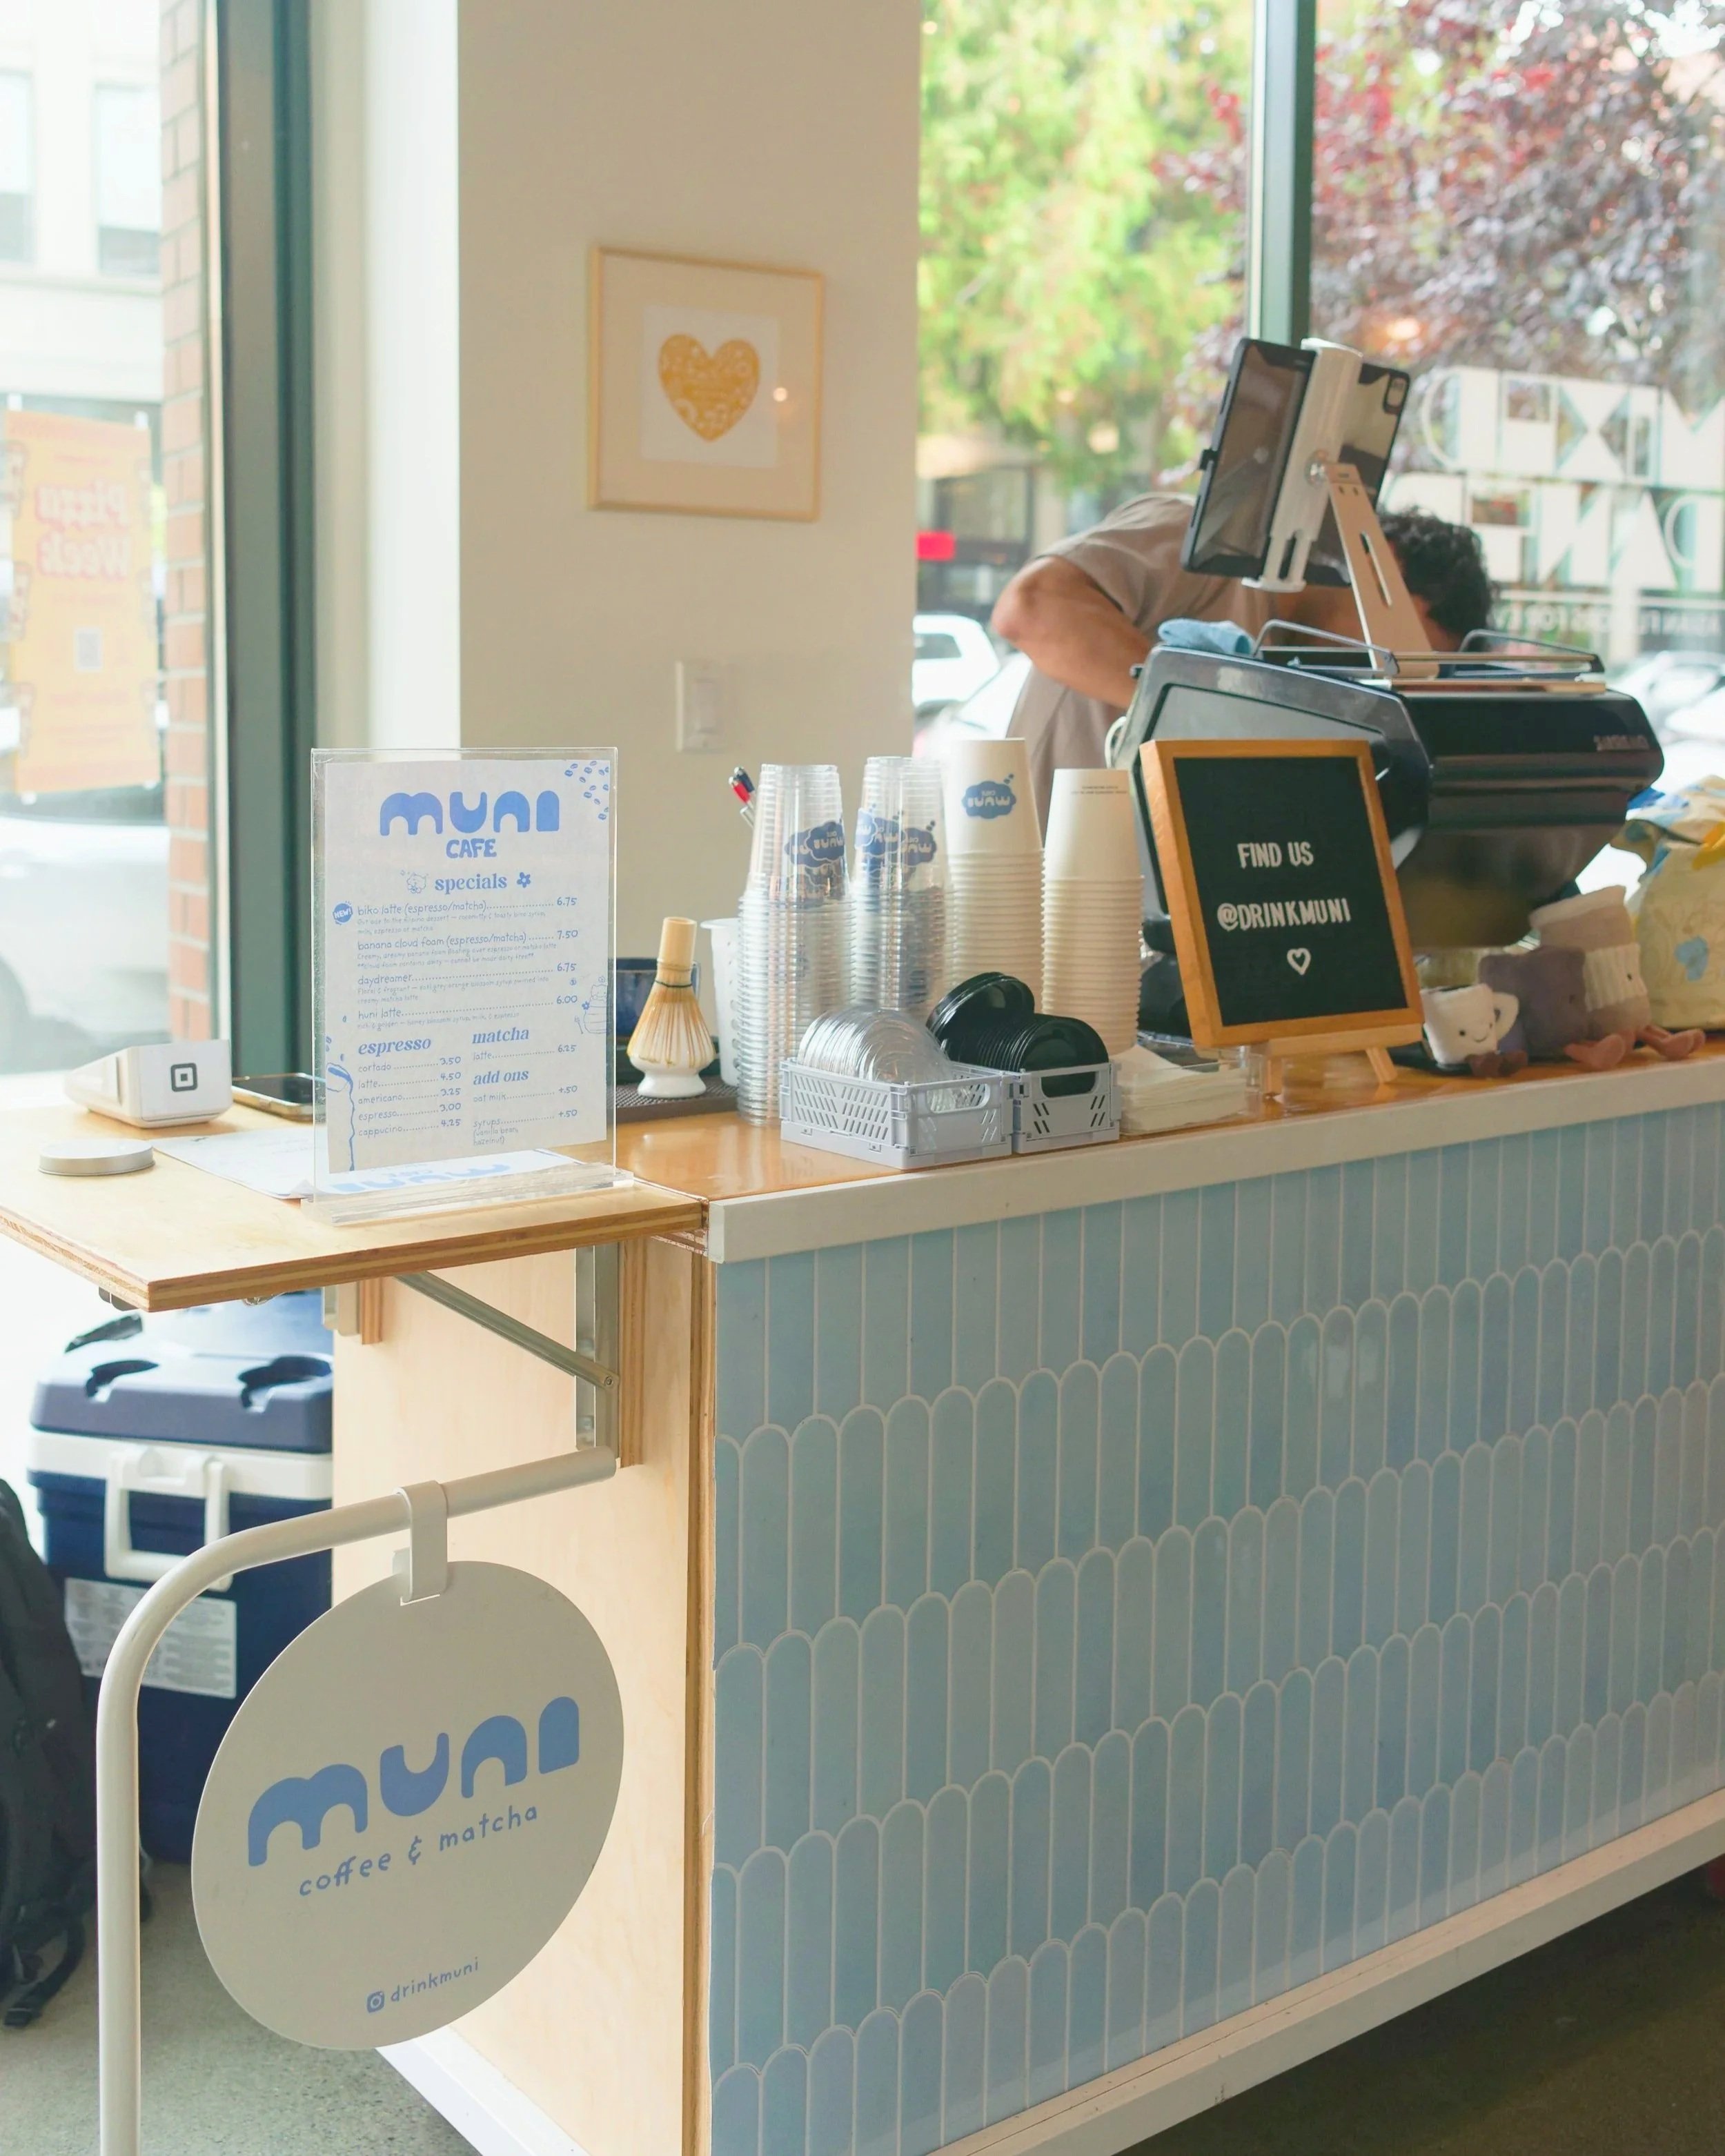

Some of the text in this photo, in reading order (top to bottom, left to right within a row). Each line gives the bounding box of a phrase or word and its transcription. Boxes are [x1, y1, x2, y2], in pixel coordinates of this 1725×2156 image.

[446, 838, 497, 858] CAFE
[1237, 841, 1314, 869] FIND US
[435, 873, 508, 895] specials
[334, 907, 353, 919] NEW!
[357, 897, 578, 916] biko latte (espresso/matcha) 6.75
[1216, 898, 1352, 931] @DRINKMUNI
[357, 930, 578, 951] banana cloud foam (espresso/matcha) 7.50
[357, 962, 577, 988] daydreamer 6.75
[381, 1007, 402, 1018] latte
[556, 995, 578, 1005] 6.00
[472, 1026, 530, 1044] matcha
[358, 1038, 431, 1057] espresso
[473, 1044, 577, 1060] latte 6.25
[358, 1056, 461, 1073] cortado 3.50
[358, 1071, 461, 1089] latte 4.50
[473, 1070, 529, 1085] add ons
[358, 1087, 461, 1105] americano 3.25
[473, 1085, 578, 1102] oat milk +.50
[358, 1102, 461, 1122] espresso 3.00
[473, 1109, 578, 1130] syrups +.50
[358, 1118, 461, 1138] cappucino 4.25
[299, 1805, 538, 1897] coffee & matcha
[391, 1957, 479, 2003] drinkmuni
